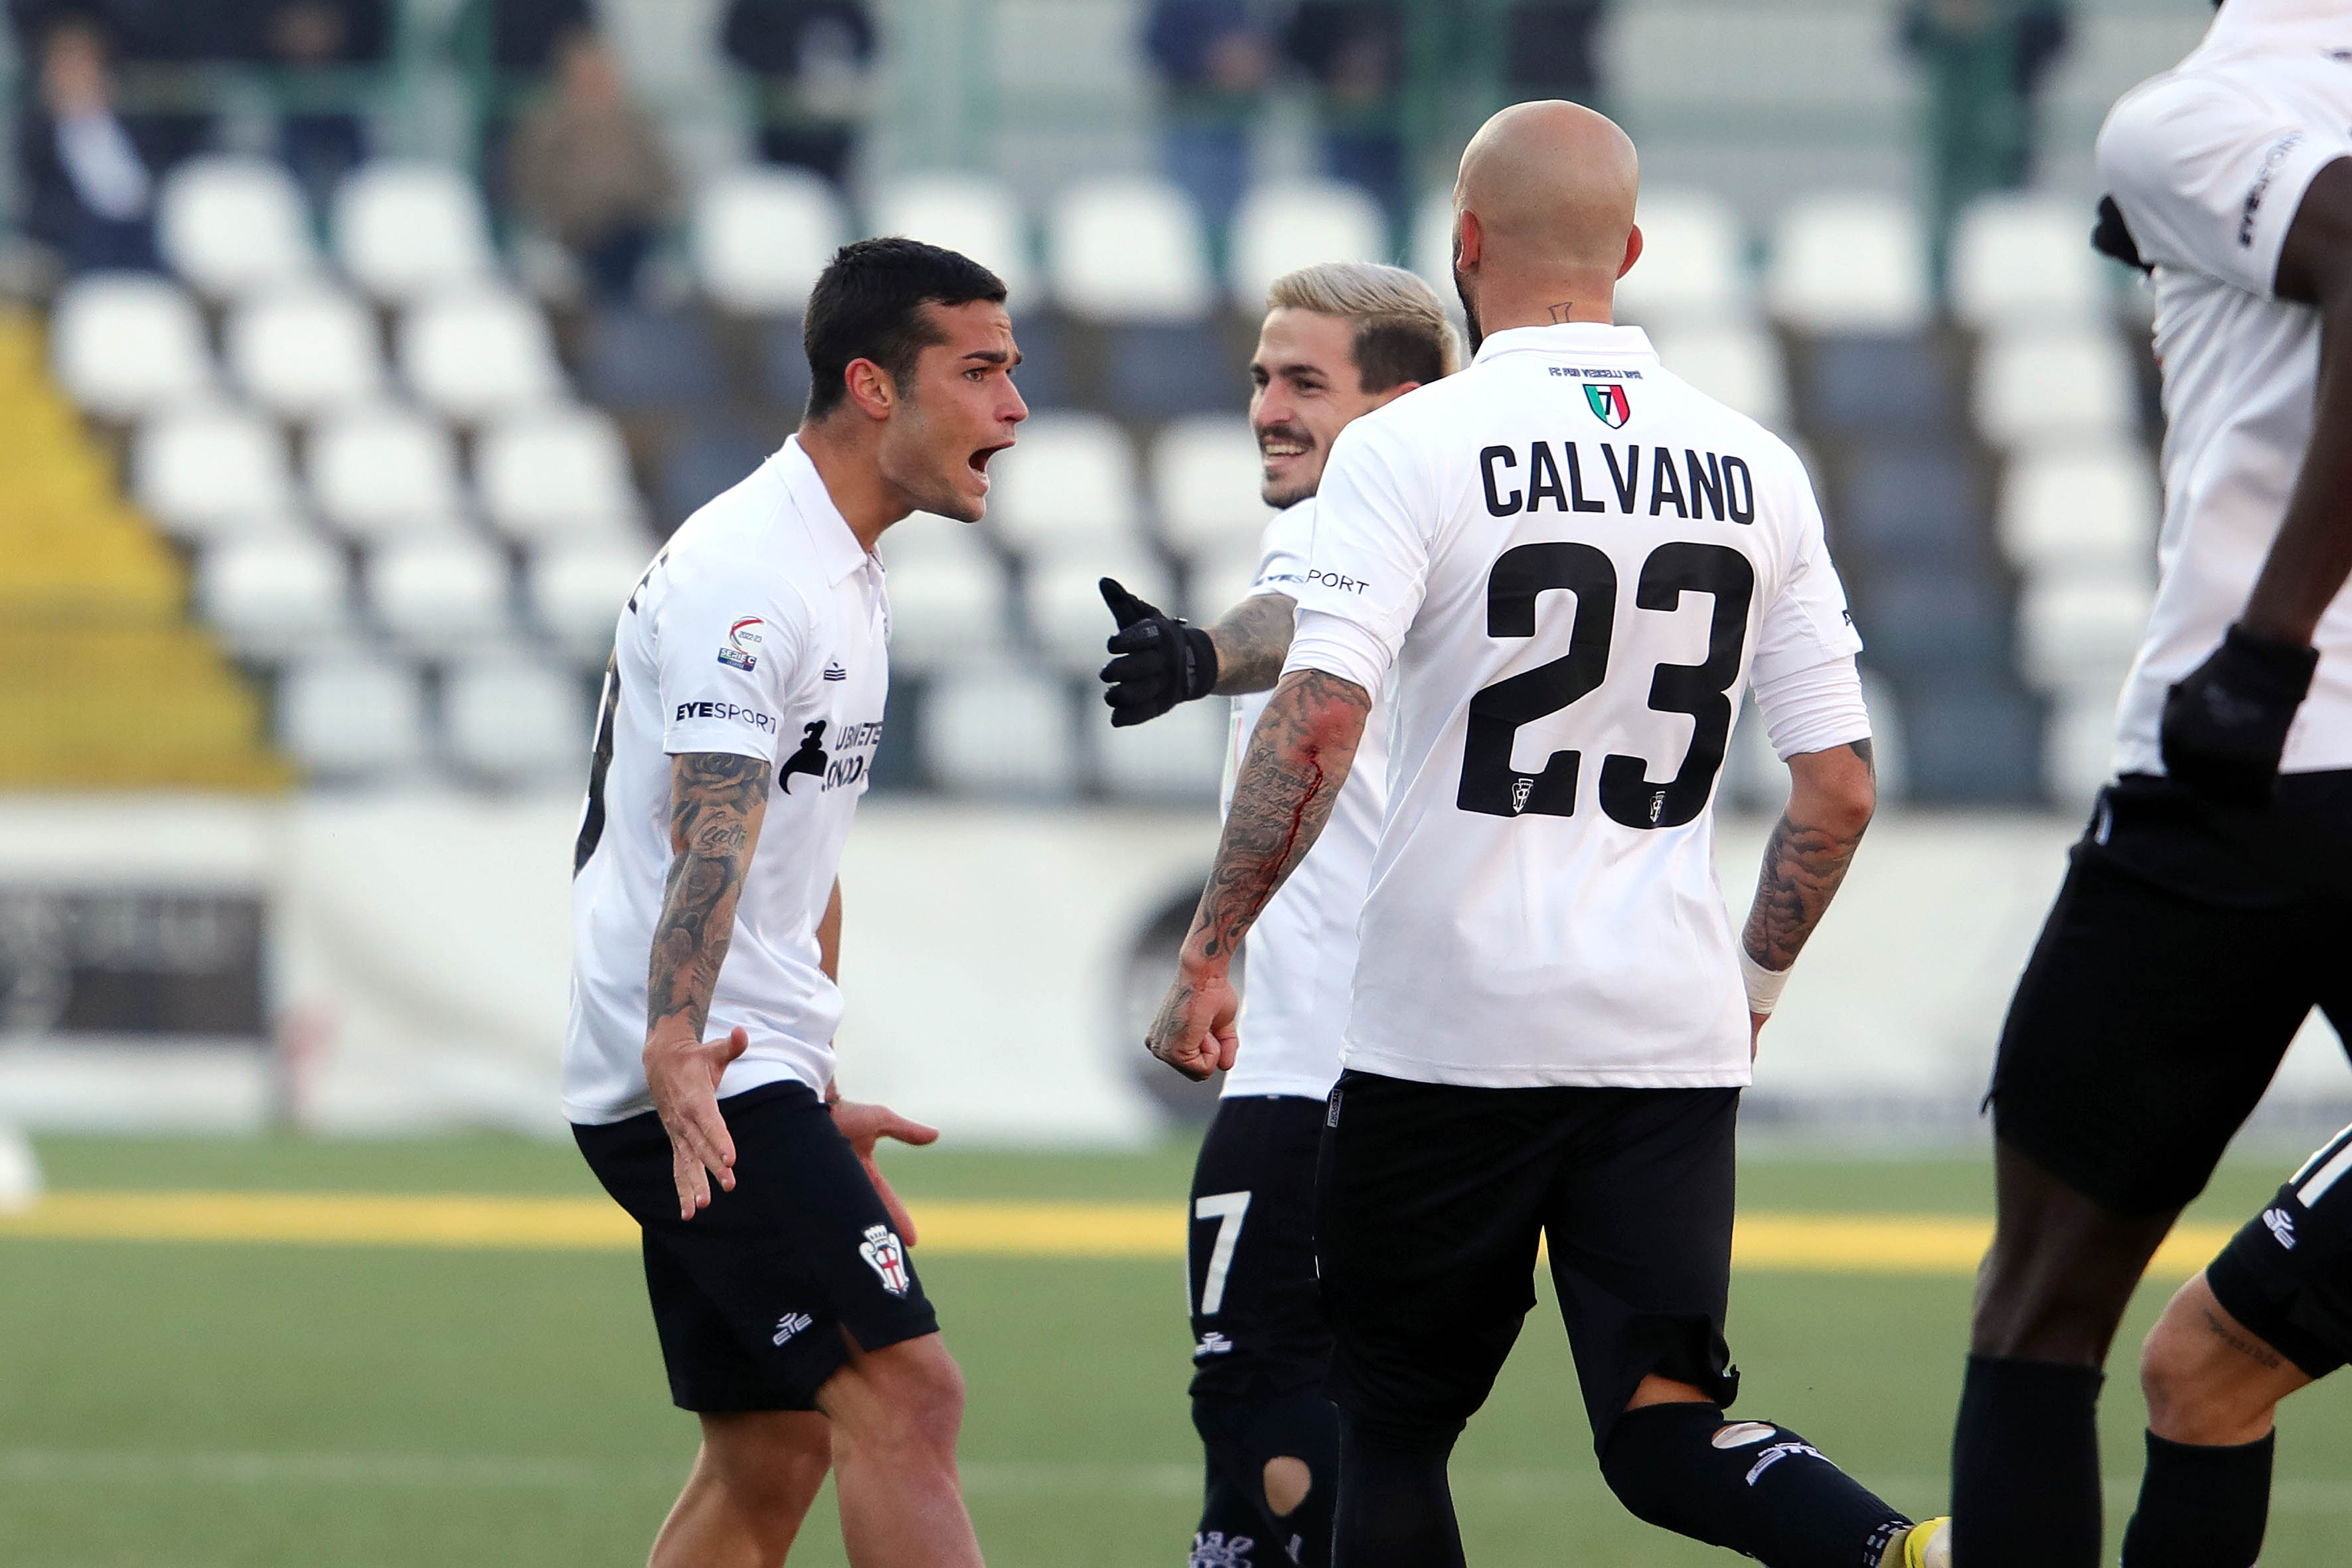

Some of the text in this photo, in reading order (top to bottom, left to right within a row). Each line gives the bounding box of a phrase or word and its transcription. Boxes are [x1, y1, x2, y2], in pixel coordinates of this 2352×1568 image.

[1480, 441, 1755, 525] CALVANO
[721, 648, 748, 663] SERIE
[1456, 542, 1755, 829] 23
[676, 701, 777, 735] EYESPORT
[1187, 1191, 1253, 1317] 7
